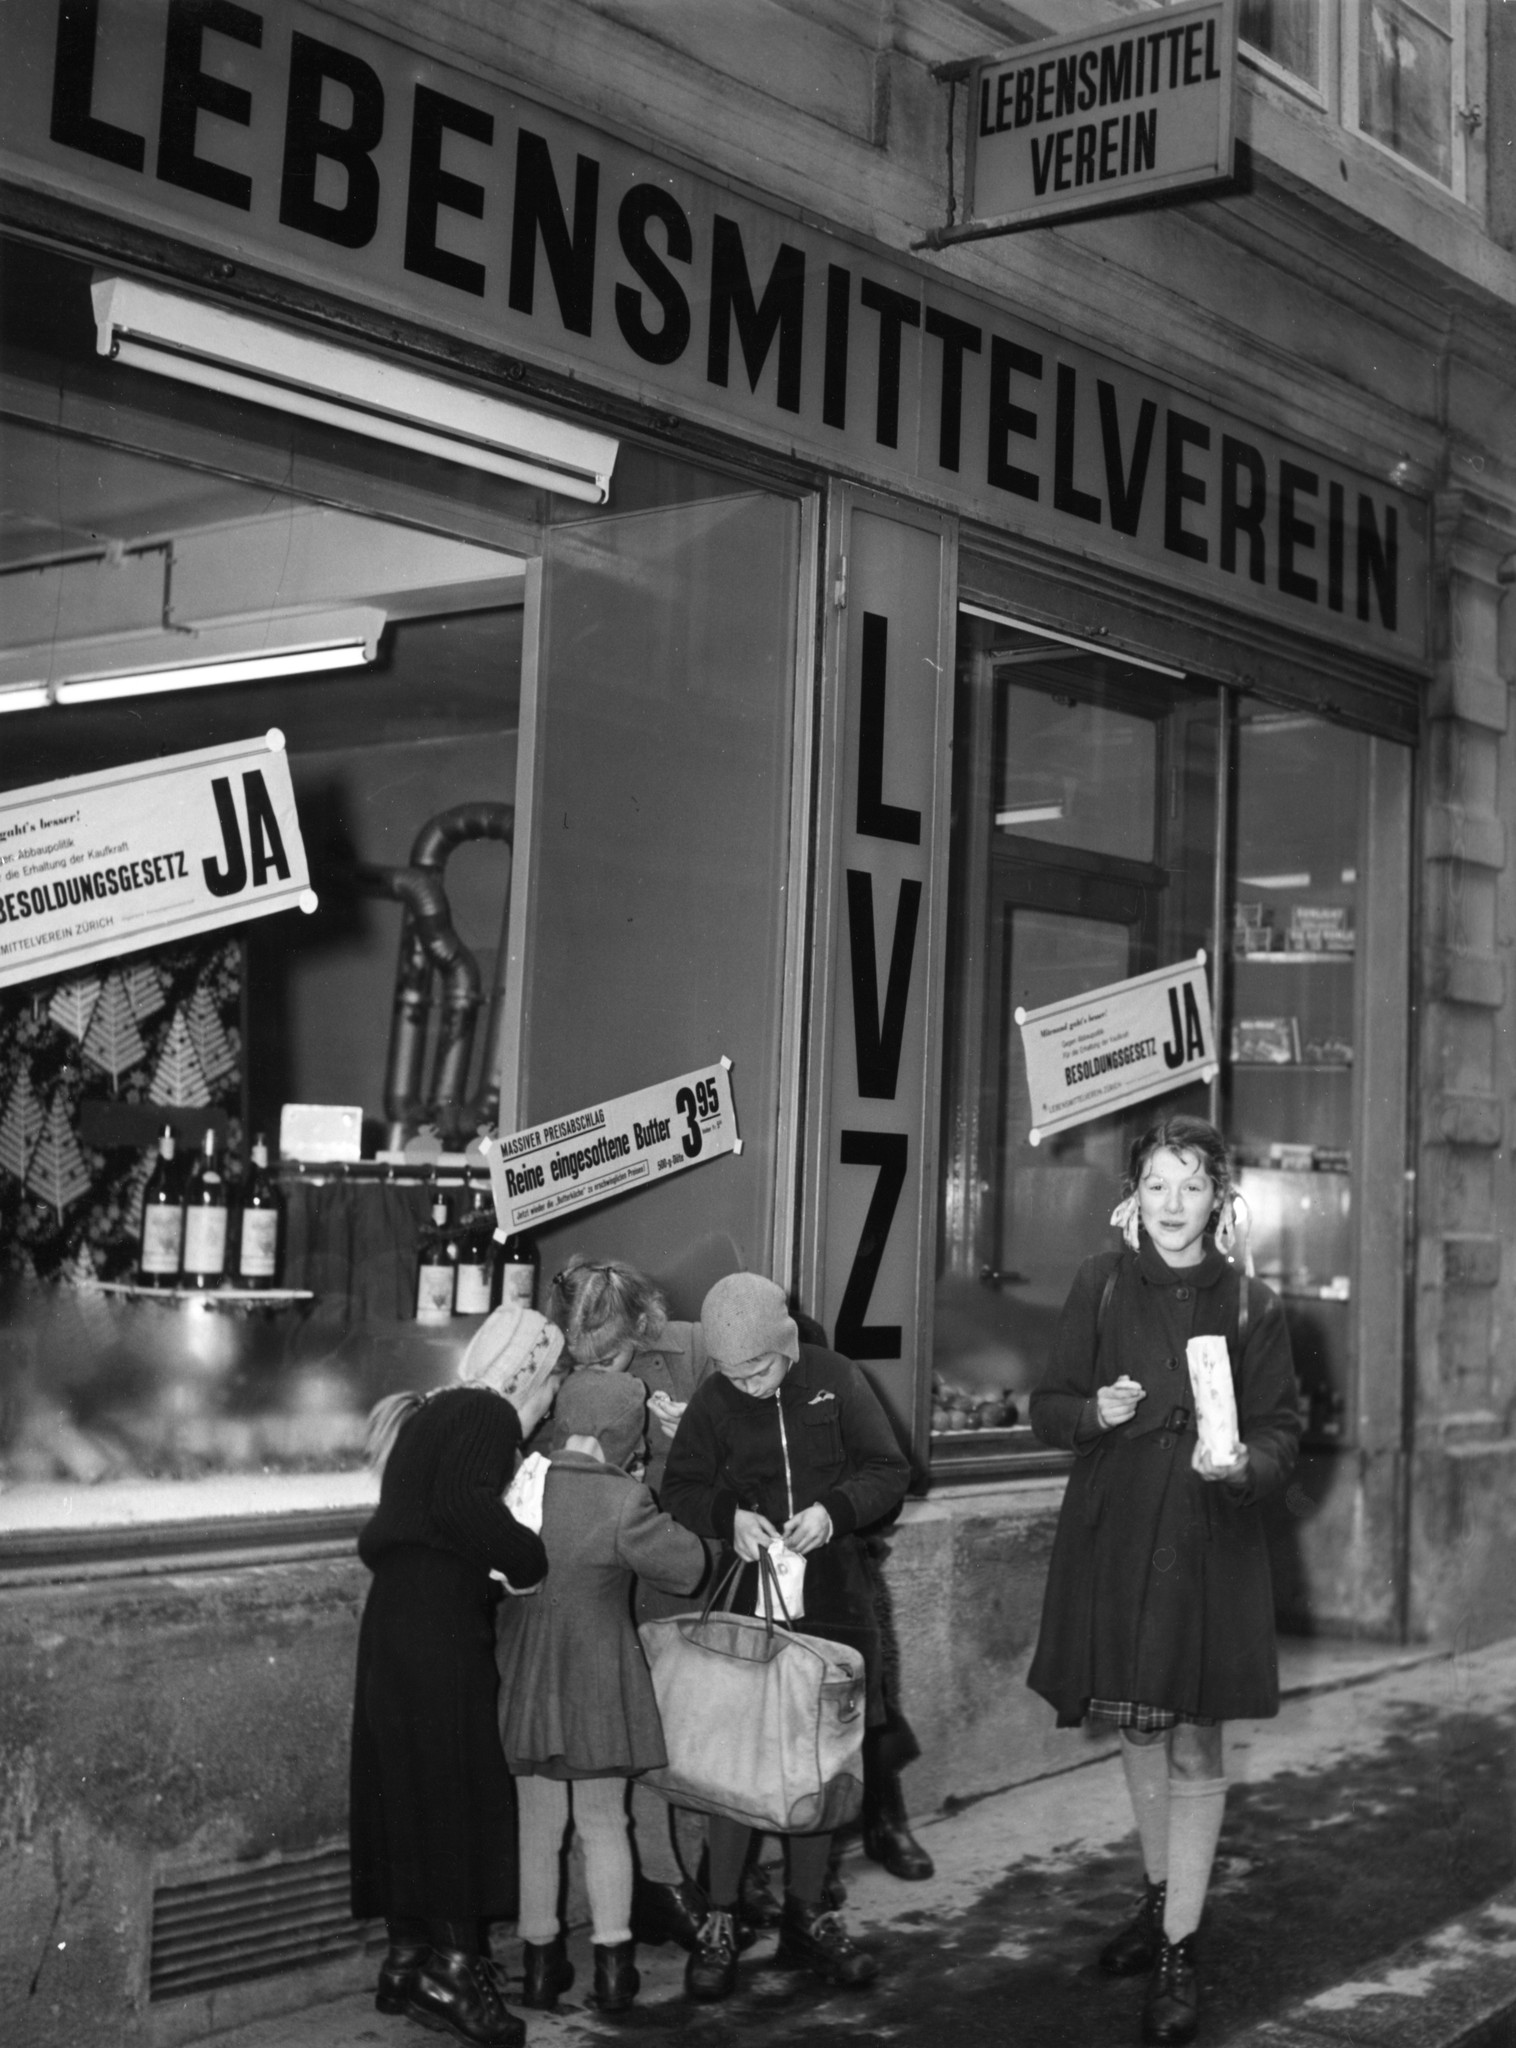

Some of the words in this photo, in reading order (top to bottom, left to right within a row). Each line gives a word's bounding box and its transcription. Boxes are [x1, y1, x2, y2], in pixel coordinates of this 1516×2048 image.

[979, 18, 1221, 137] LEBENSMITTEL
[1030, 108, 1157, 196] VEREIN
[50, 0, 1398, 632] LEBENSMITTELVEREIN
[18, 838, 75, 861] Abbaupolitik
[40, 809, 80, 829] besser!
[202, 769, 291, 898] JA
[0, 851, 188, 924] BESOLDUNGSGESETZ
[22, 856, 67, 877] Erhaltung
[69, 853, 85, 865] der
[87, 841, 129, 860] Kaufkraft
[75, 915, 115, 935] ZÜRICH
[834, 611, 922, 1359] LVZ
[1065, 1036, 1157, 1086] BESOLDUNGSGESETZ
[1163, 981, 1205, 1069] JA
[500, 1131, 542, 1158] MASSIVER
[543, 1108, 606, 1143] PREISABSCHLAG
[505, 1163, 545, 1198] Reine
[550, 1132, 631, 1181] eingesottene
[633, 1117, 671, 1151] Butter
